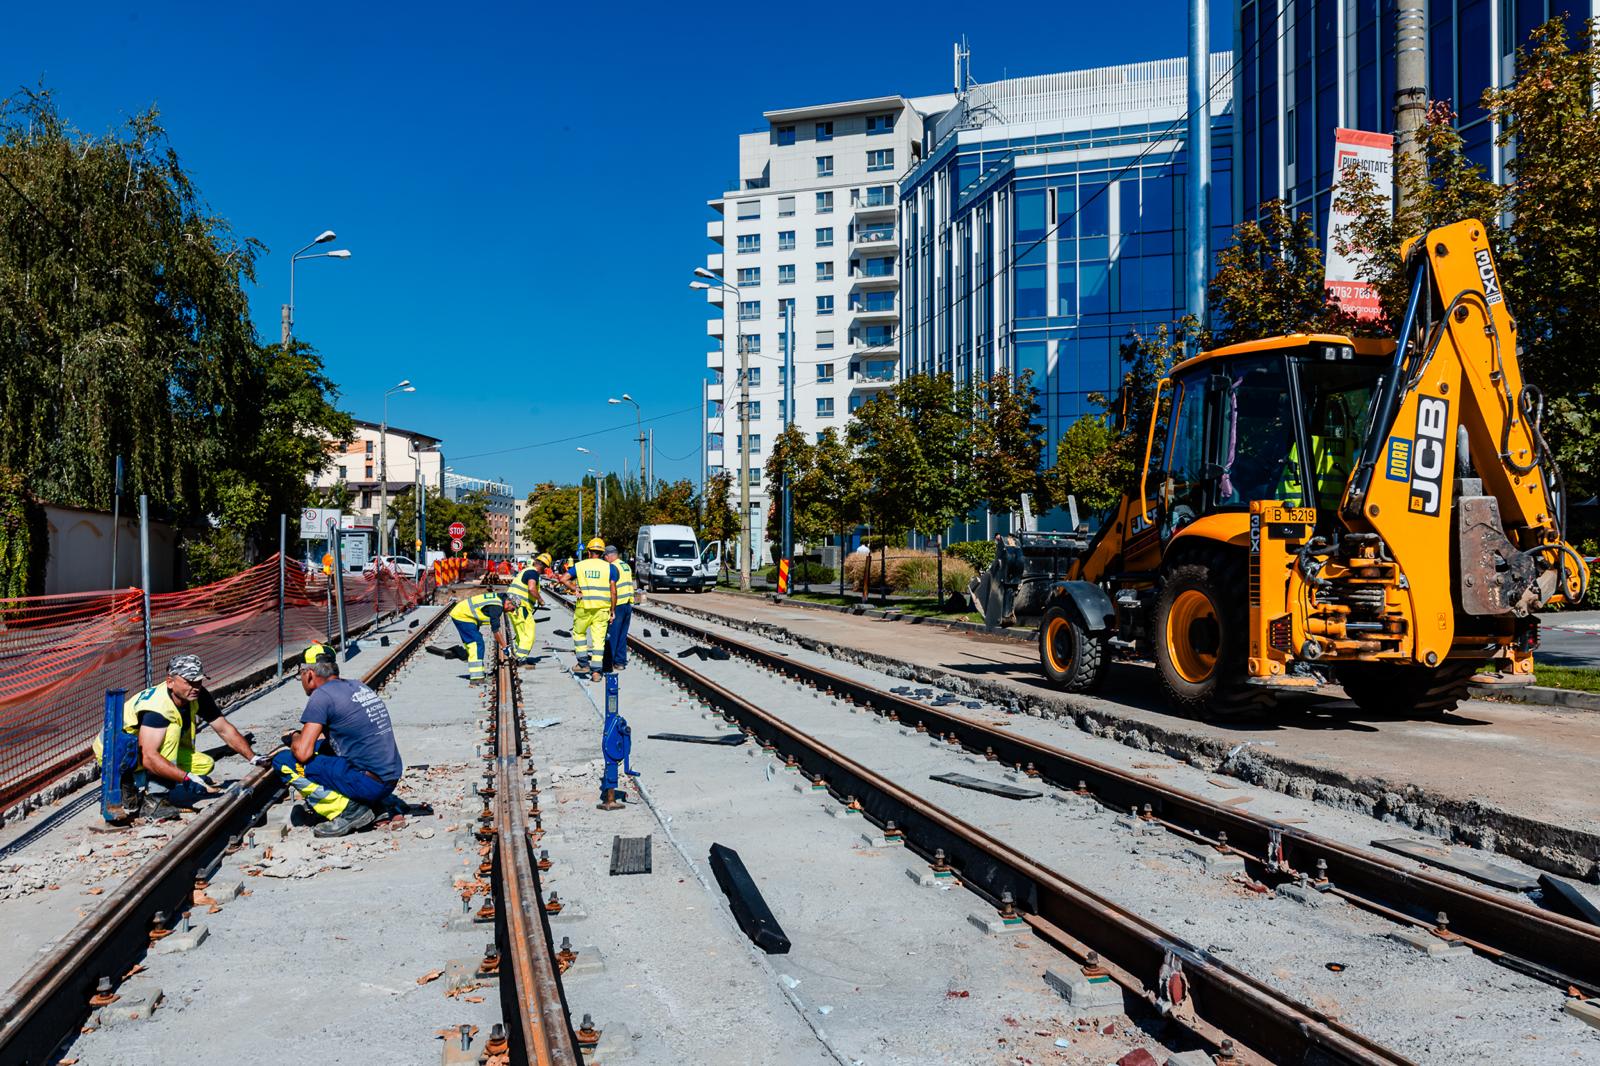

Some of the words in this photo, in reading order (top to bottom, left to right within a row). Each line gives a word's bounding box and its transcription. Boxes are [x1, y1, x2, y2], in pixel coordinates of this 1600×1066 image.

[1475, 250, 1499, 294] 3CX
[1412, 398, 1446, 513] JCB
[449, 527, 465, 535] STOP
[1251, 515, 1260, 551] 3CX
[1274, 510, 1282, 521] B
[1288, 510, 1314, 521] 15219
